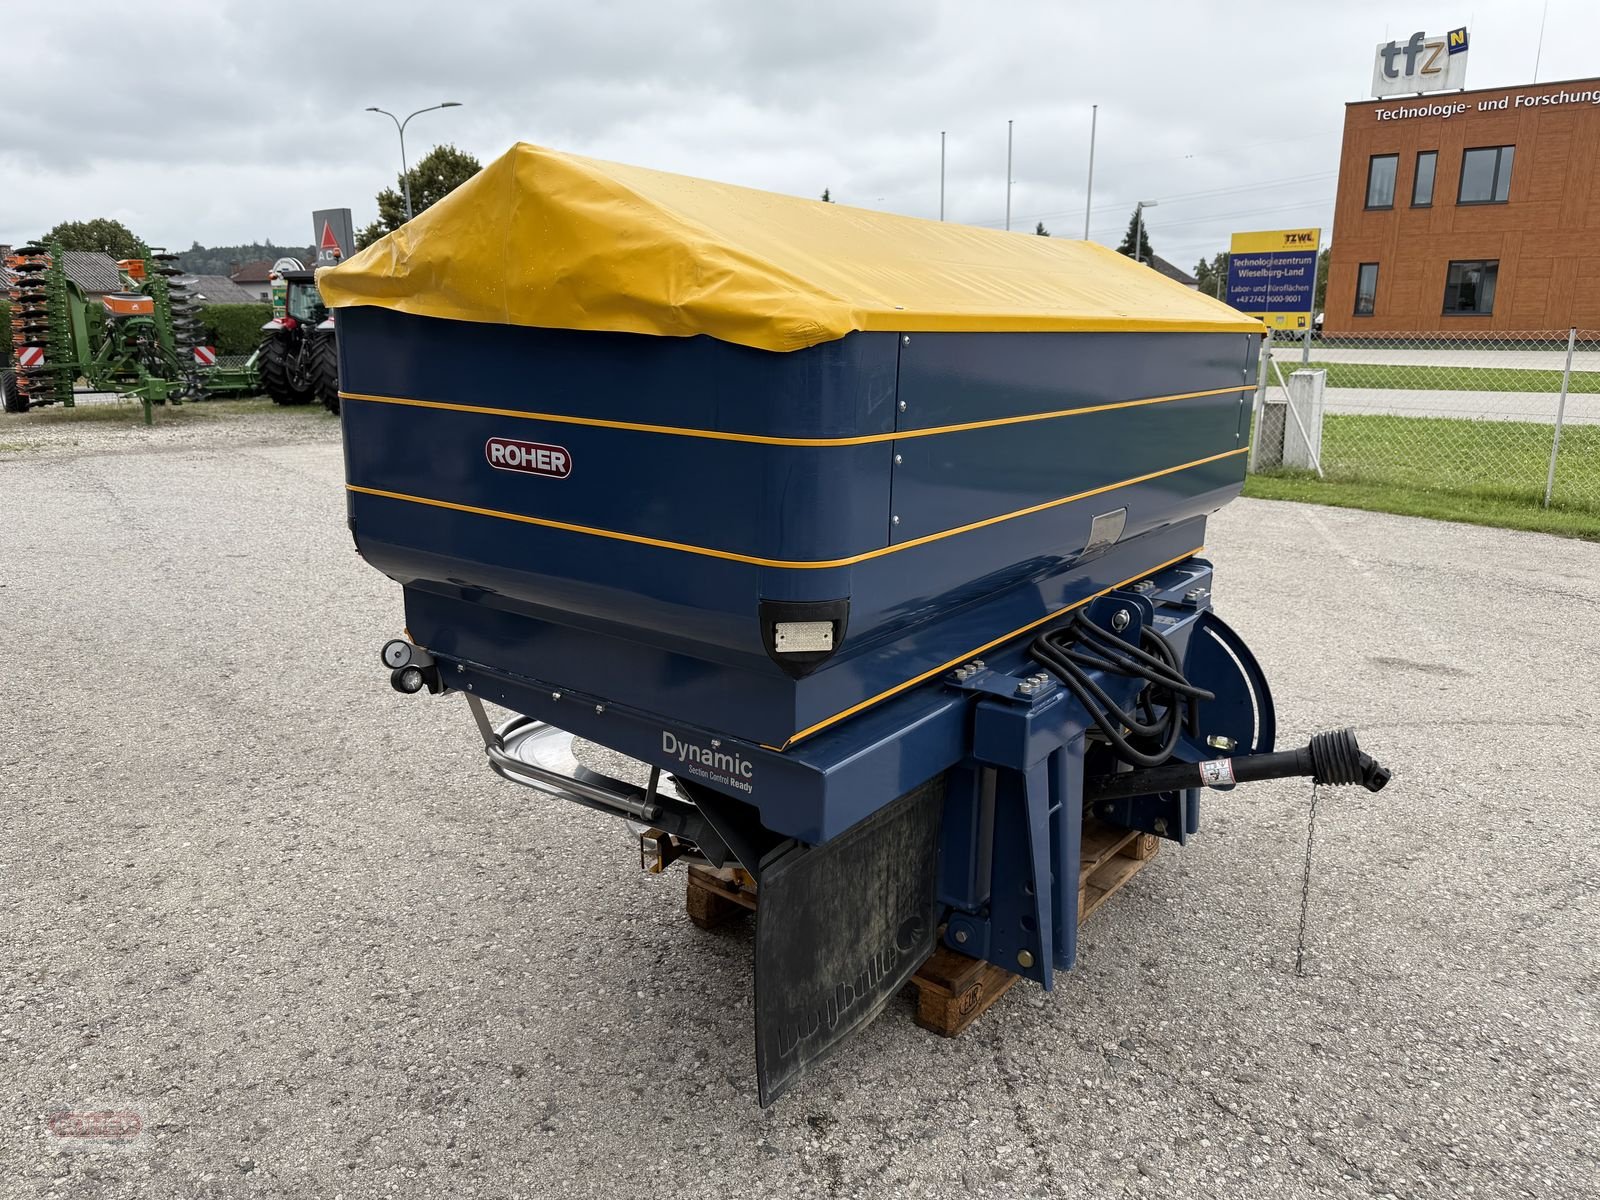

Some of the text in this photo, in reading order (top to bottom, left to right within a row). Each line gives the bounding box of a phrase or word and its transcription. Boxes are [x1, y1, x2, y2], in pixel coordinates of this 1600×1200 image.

[1381, 31, 1445, 78] tfz
[1375, 103, 1472, 121] Technologie-
[1478, 96, 1508, 112] und
[1285, 233, 1312, 242] TZWL
[1238, 268, 1304, 278] Wieselburg-Land
[490, 443, 566, 473] ROHER
[662, 730, 753, 778] Dynamic
[688, 764, 753, 794] Section Control Ready
